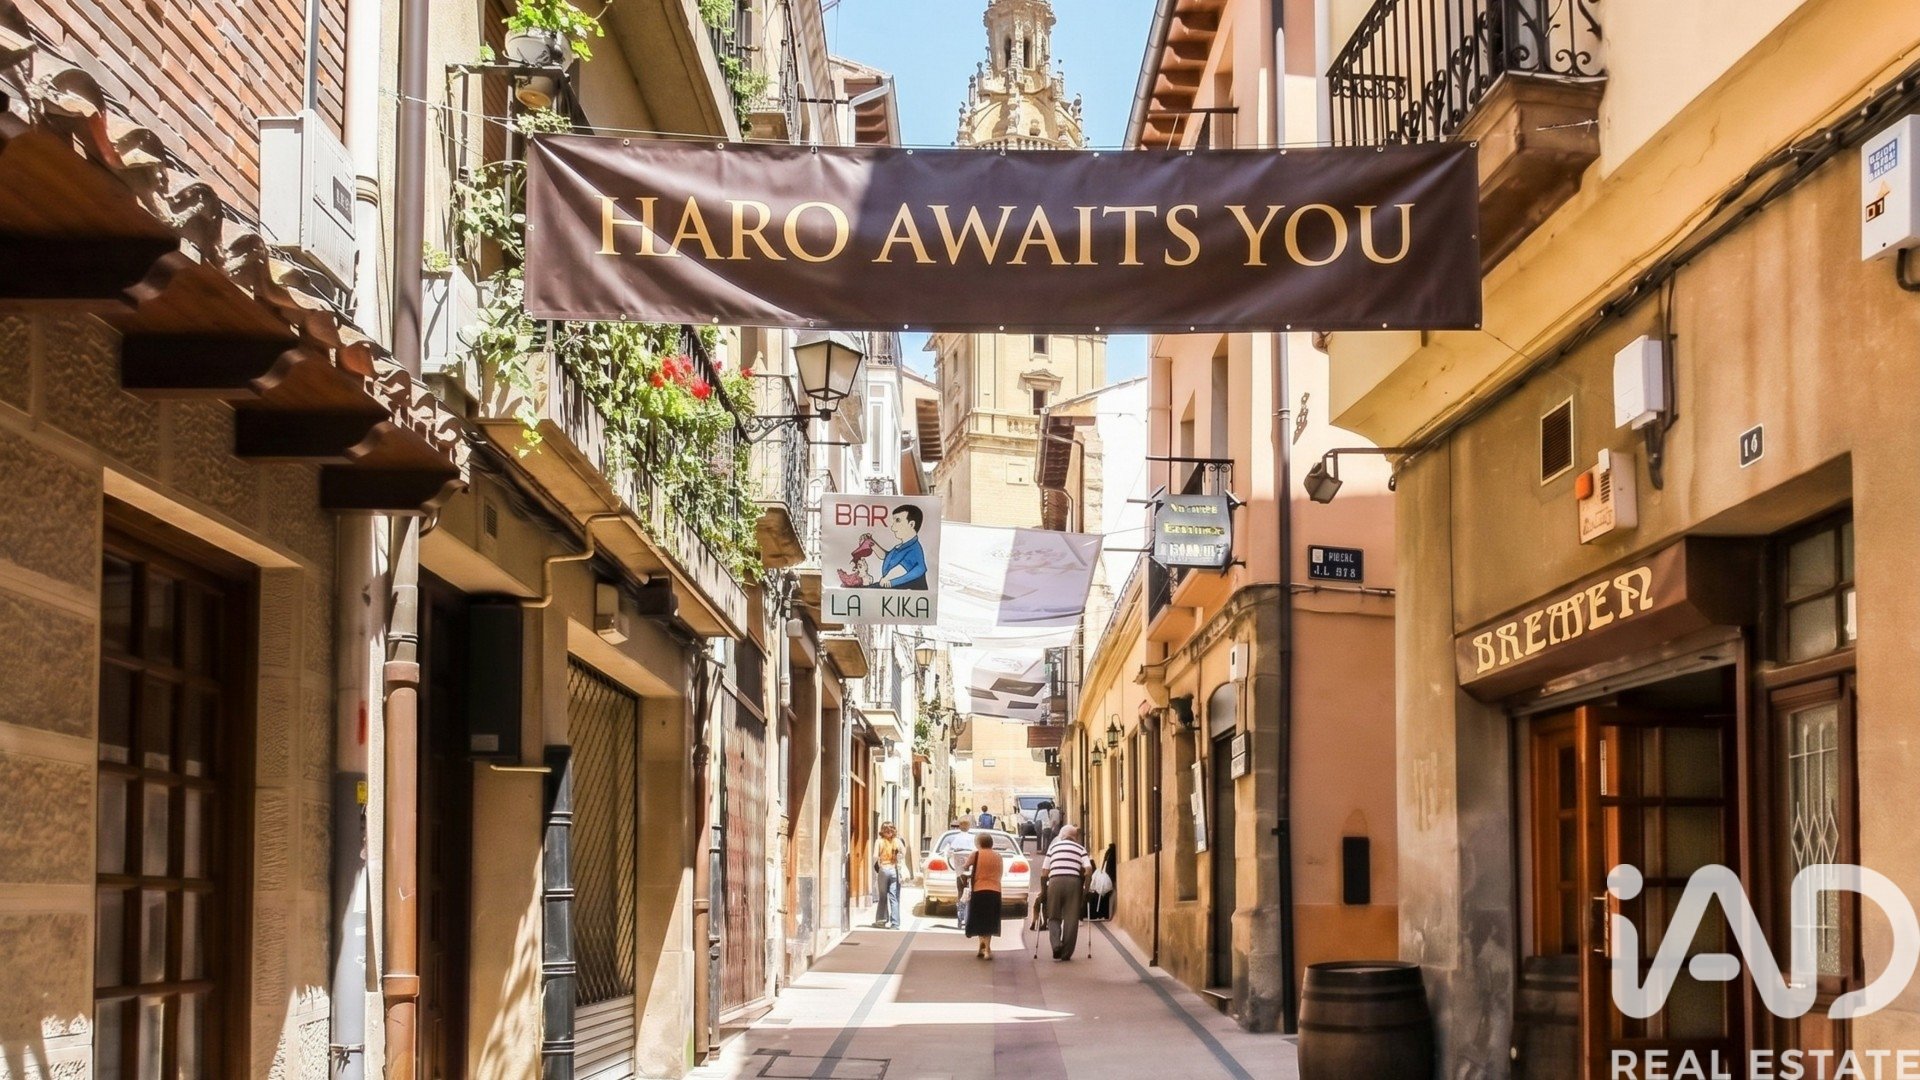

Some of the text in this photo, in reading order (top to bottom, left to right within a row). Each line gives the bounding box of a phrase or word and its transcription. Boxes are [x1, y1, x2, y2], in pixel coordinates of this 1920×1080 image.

[594, 194, 1415, 266] HARO AWAITS YOU
[835, 503, 889, 527] BAR
[831, 594, 929, 618] LA KIKA
[1472, 566, 1654, 675] BREMEN
